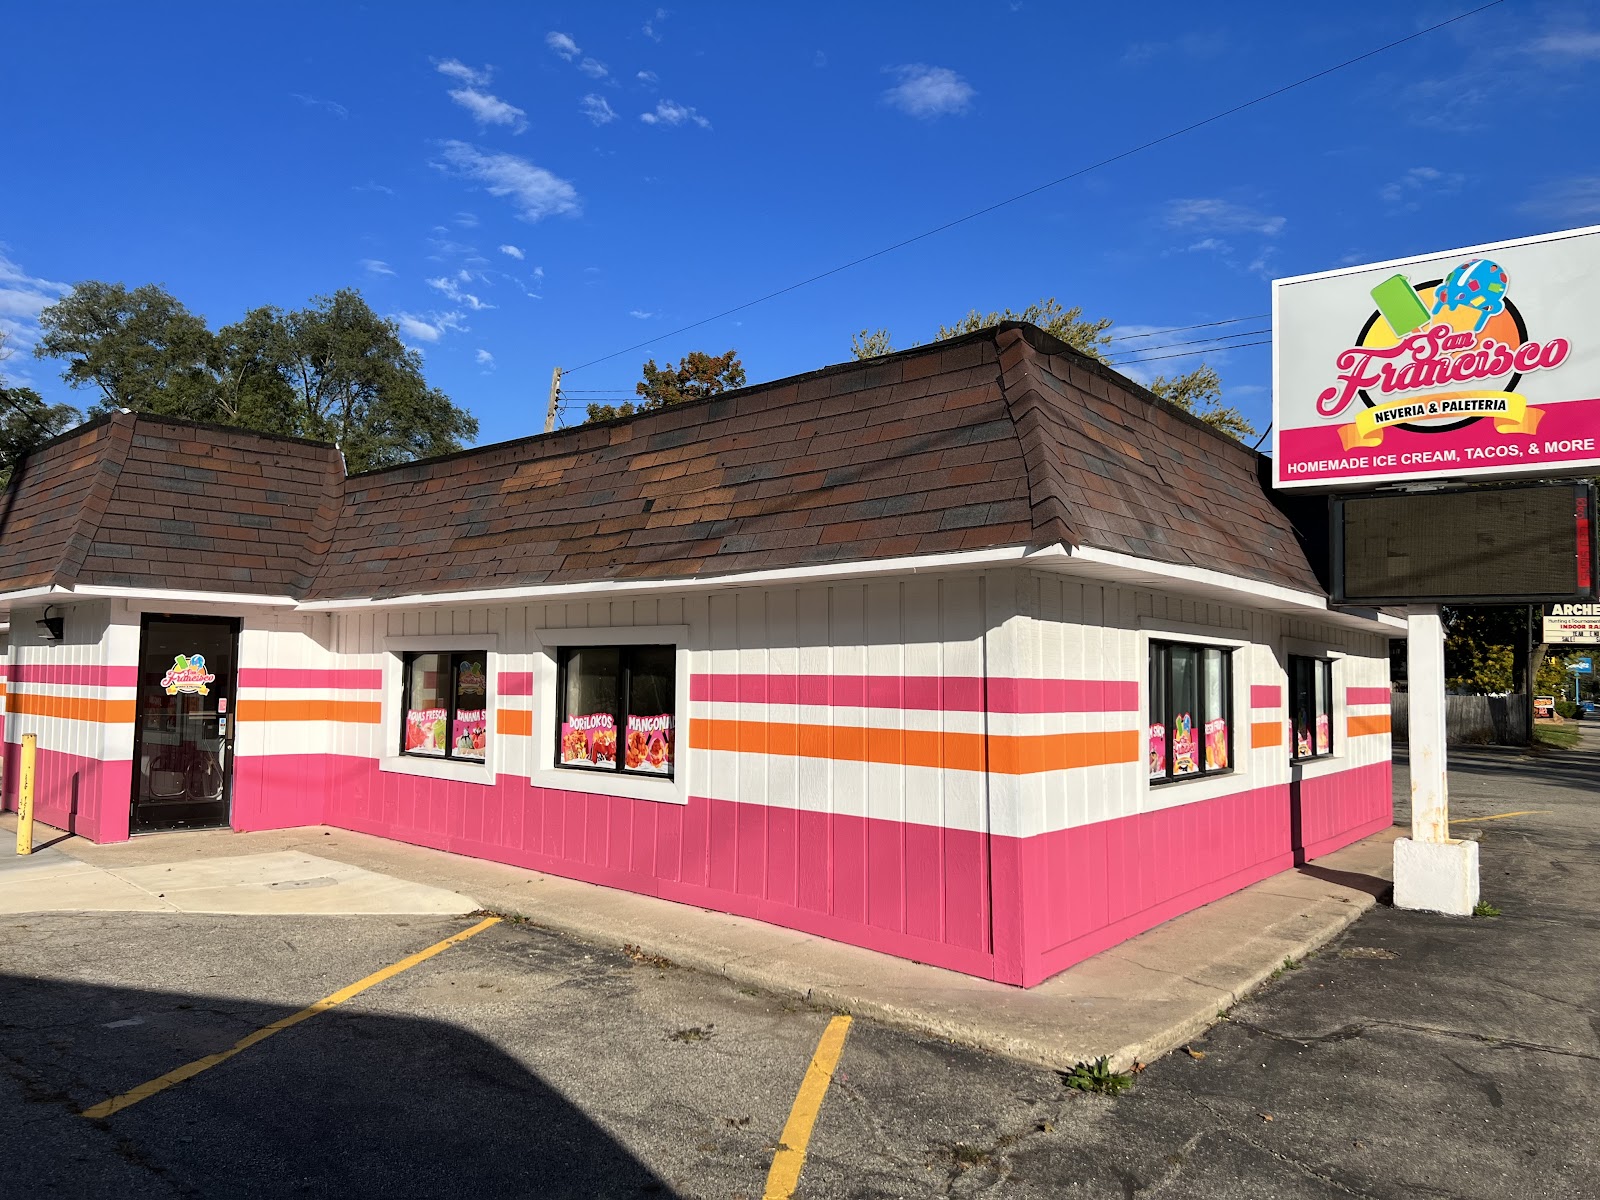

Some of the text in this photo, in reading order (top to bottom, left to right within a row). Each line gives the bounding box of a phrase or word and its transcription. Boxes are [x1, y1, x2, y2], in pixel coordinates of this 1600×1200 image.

[1410, 324, 1475, 361] San
[1316, 338, 1569, 417] Francisco
[1374, 399, 1507, 423] NEVERIA & PALETERIA
[1287, 438, 1595, 474] HOMEMADE ICE CREAM, TACOS, & MORE
[1551, 603, 1600, 616] ARCHE
[162, 670, 214, 686] Francisco
[457, 710, 481, 722] BANANA
